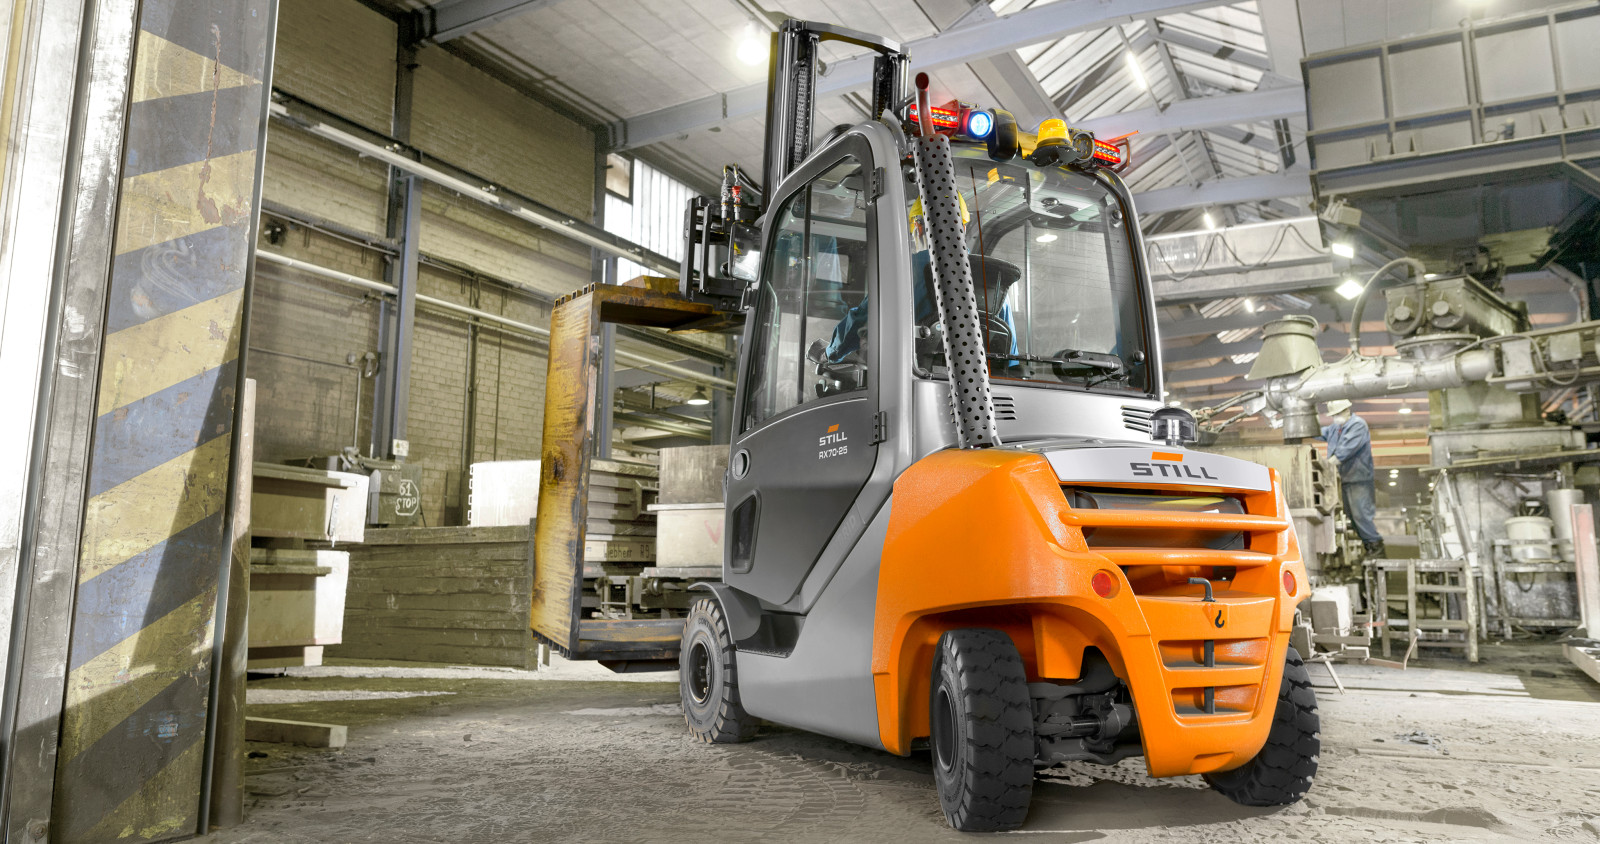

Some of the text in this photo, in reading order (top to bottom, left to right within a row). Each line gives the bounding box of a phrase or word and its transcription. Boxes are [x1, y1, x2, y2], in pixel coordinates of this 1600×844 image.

[819, 431, 848, 447] STILL
[1129, 462, 1219, 480] STILL
[396, 497, 417, 511] STOP
